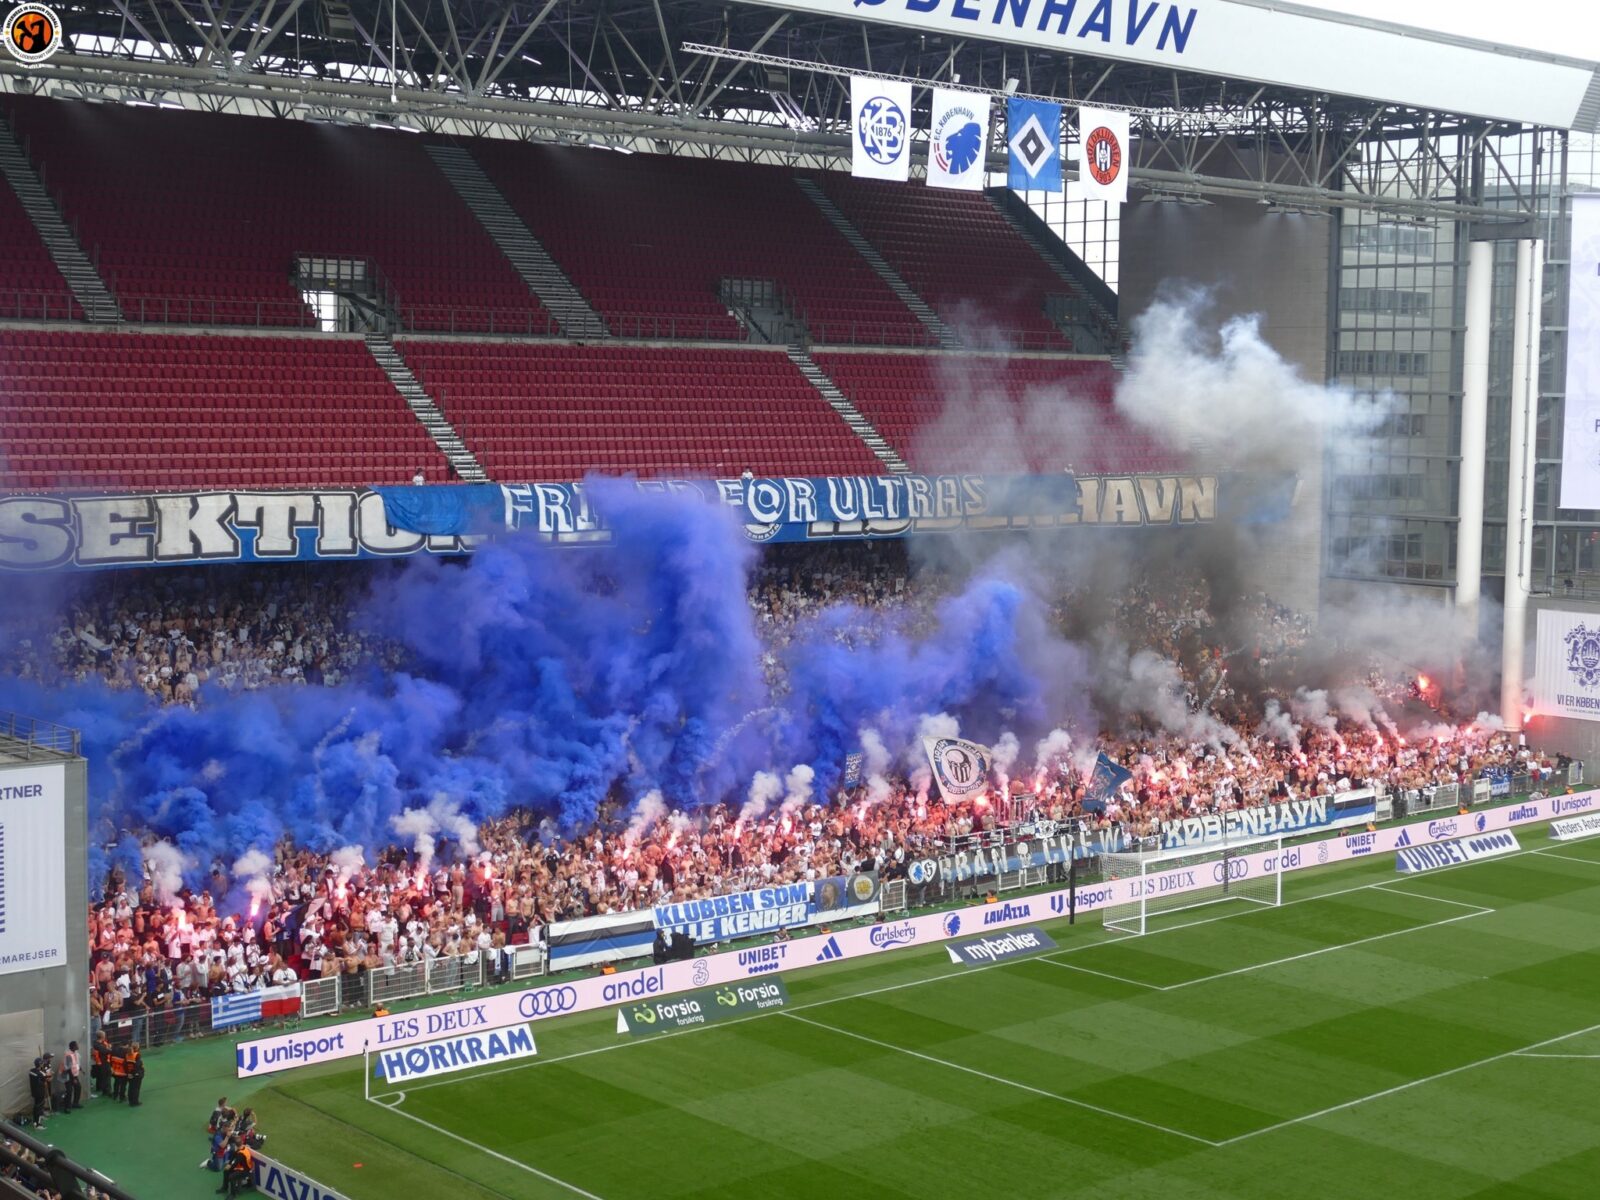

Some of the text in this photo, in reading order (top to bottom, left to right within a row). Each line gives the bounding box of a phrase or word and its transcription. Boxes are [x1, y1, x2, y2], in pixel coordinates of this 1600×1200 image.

[853, 0, 1198, 53] NHAVN
[940, 107, 975, 130] KØBENHAVN
[875, 127, 893, 138] 1876
[716, 476, 817, 523] FOR
[829, 474, 991, 522] ULTRAS
[1508, 805, 1538, 821] LAVAZZA
[1561, 796, 1592, 811] unisport
[1162, 799, 1327, 848] KØBENHAVN
[1428, 819, 1457, 839] Carlsberg
[1345, 833, 1376, 849] UNIBET
[1403, 840, 1469, 871] UNIBET
[1160, 871, 1195, 893] DEUX
[655, 883, 807, 927] KLUBBEN SOM
[984, 904, 1030, 925] LAVAZZA
[721, 904, 808, 937] KENDER
[870, 922, 916, 948] Carlsberg
[0, 949, 57, 965] MAREJSER
[738, 944, 787, 966] UNIBET
[964, 932, 1041, 961] mybanker
[603, 967, 664, 1002] andel
[738, 983, 780, 1003] forsia
[656, 999, 701, 1021] forsia
[757, 996, 783, 1010] forsikring
[377, 1005, 488, 1043] LES DEUX
[677, 1012, 704, 1027] forsikring
[264, 1032, 344, 1062] unisport
[384, 1027, 533, 1079] HØRKRAM
